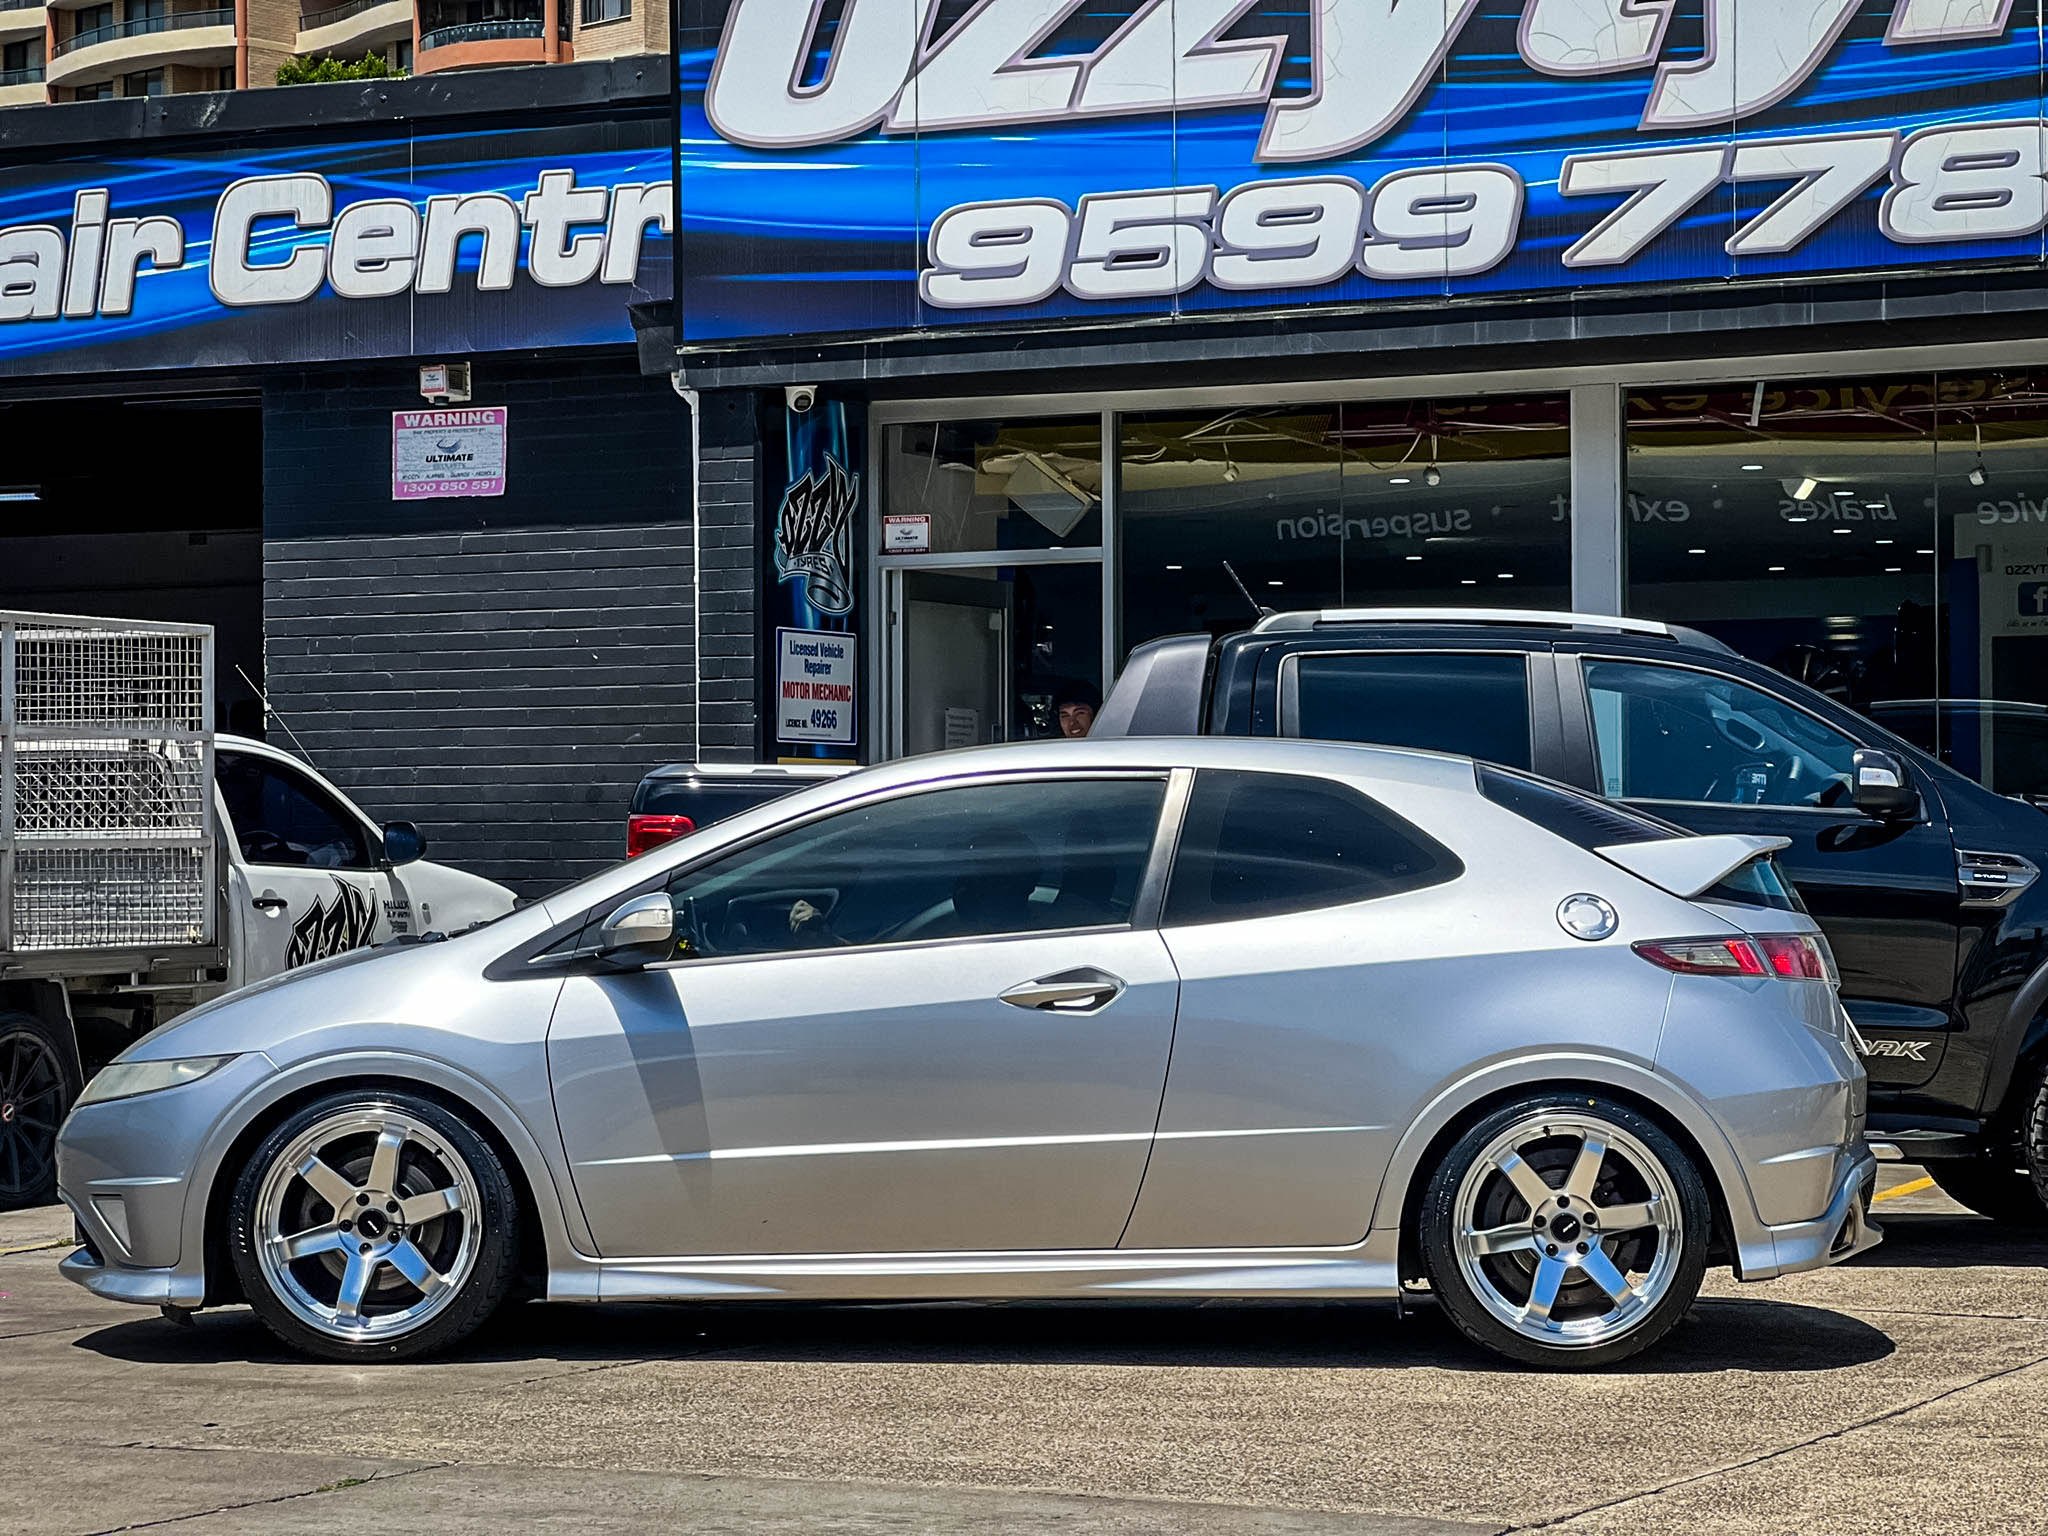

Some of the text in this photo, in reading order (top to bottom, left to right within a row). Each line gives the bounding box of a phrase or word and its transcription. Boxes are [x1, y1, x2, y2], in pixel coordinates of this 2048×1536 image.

[919, 118, 2048, 309] 9599 778
[0, 172, 672, 321] air Centr
[403, 411, 496, 428] WARNING
[426, 453, 474, 463] ULTIMATE
[404, 483, 436, 493] 1300
[888, 516, 926, 524] WARNING
[796, 556, 830, 573] TYRES
[789, 640, 844, 659] Licensed Vehicle
[804, 658, 832, 677] Repairer
[783, 681, 851, 703] MOTOR MECHANIC
[811, 708, 837, 729] 49266
